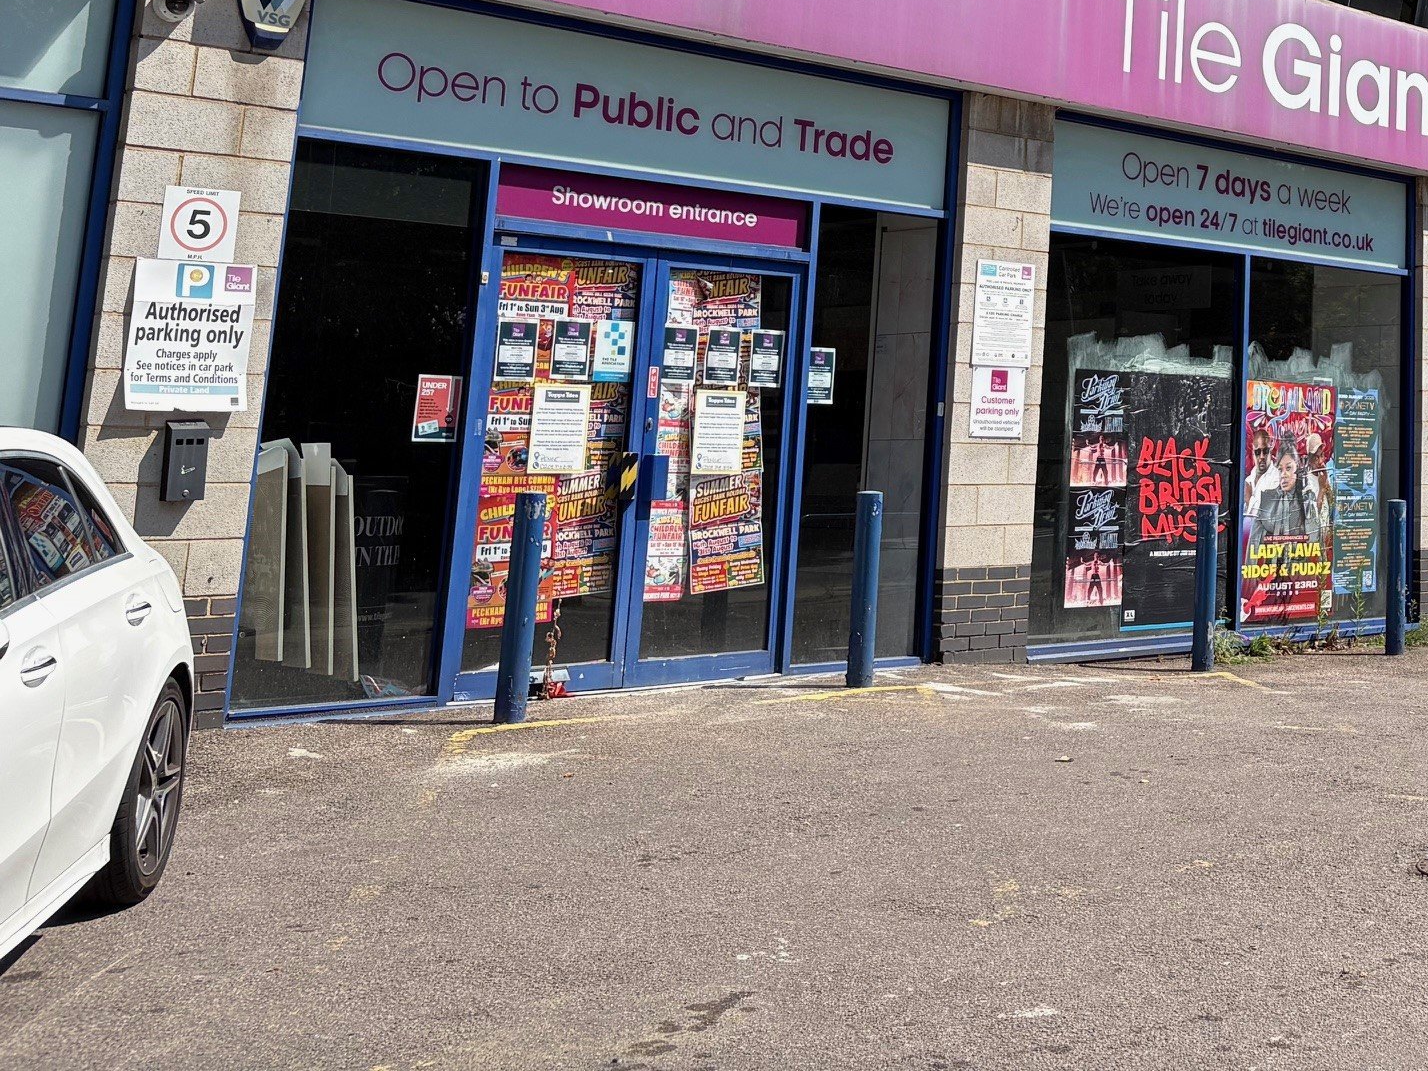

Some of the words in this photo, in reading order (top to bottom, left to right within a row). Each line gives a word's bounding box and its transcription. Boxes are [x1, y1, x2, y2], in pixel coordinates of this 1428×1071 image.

[257, 10, 291, 27] VSG
[377, 52, 507, 106] Open
[521, 76, 559, 114] to
[573, 82, 701, 136] Public
[711, 112, 783, 148] and
[793, 118, 895, 165] Trade
[1122, 151, 1190, 189] Open
[1196, 164, 1209, 191] 7
[1215, 169, 1272, 204] days
[1277, 183, 1291, 205] a
[1297, 186, 1352, 215] week
[205, 189, 220, 197] LIMIT
[551, 185, 664, 217] Showroom
[669, 204, 758, 227] entrance
[186, 209, 211, 240] 5
[1090, 191, 1141, 220] We're
[1146, 204, 1195, 227] open
[1200, 208, 1238, 233] 24/7
[1242, 218, 1259, 236] at
[1262, 218, 1374, 252] tilegiant.co.uk
[228, 274, 242, 282] Tile
[575, 266, 629, 286] UNFAIR
[226, 281, 250, 291] Giant
[500, 281, 569, 300] FUNFAIR
[710, 278, 749, 299] NFAIR
[145, 301, 242, 324] Authorised
[524, 303, 540, 313] Sun
[554, 305, 565, 315] Aug
[693, 308, 737, 319] BROCKWELL
[737, 308, 759, 317] PARK
[134, 322, 202, 348] parking
[206, 324, 245, 349] only
[155, 348, 191, 361] Charges
[193, 349, 218, 363] apply
[136, 360, 152, 370] See
[154, 360, 186, 371] notices
[188, 361, 197, 372] in
[198, 364, 212, 372] car
[214, 362, 234, 376] park
[130, 371, 143, 382] for
[146, 372, 172, 383] Terms
[173, 373, 191, 383] and
[193, 373, 239, 384] Conditions
[421, 382, 448, 390] UNDER
[650, 368, 659, 397] PULL
[159, 385, 189, 394] Private
[189, 385, 210, 394] Land
[489, 395, 533, 413] FUNF
[981, 395, 1016, 405] Customer
[975, 407, 1003, 417] parking
[1004, 408, 1020, 417] only
[490, 416, 501, 426] Fri
[1136, 435, 1212, 479] BLACK
[695, 474, 742, 499] SUMMER
[1138, 473, 1223, 515] BRITISH
[557, 498, 605, 522] UNFAIR
[693, 494, 749, 524] FUNFAIR
[691, 526, 738, 541] BROCKWELL
[739, 524, 760, 535] PARK
[480, 546, 492, 556] Fri
[1250, 543, 1285, 559] LADY
[1288, 542, 1322, 558] LAVA
[1279, 563, 1289, 577] &
[1257, 581, 1293, 591] AUGUST
[1294, 580, 1318, 589] 23RD
